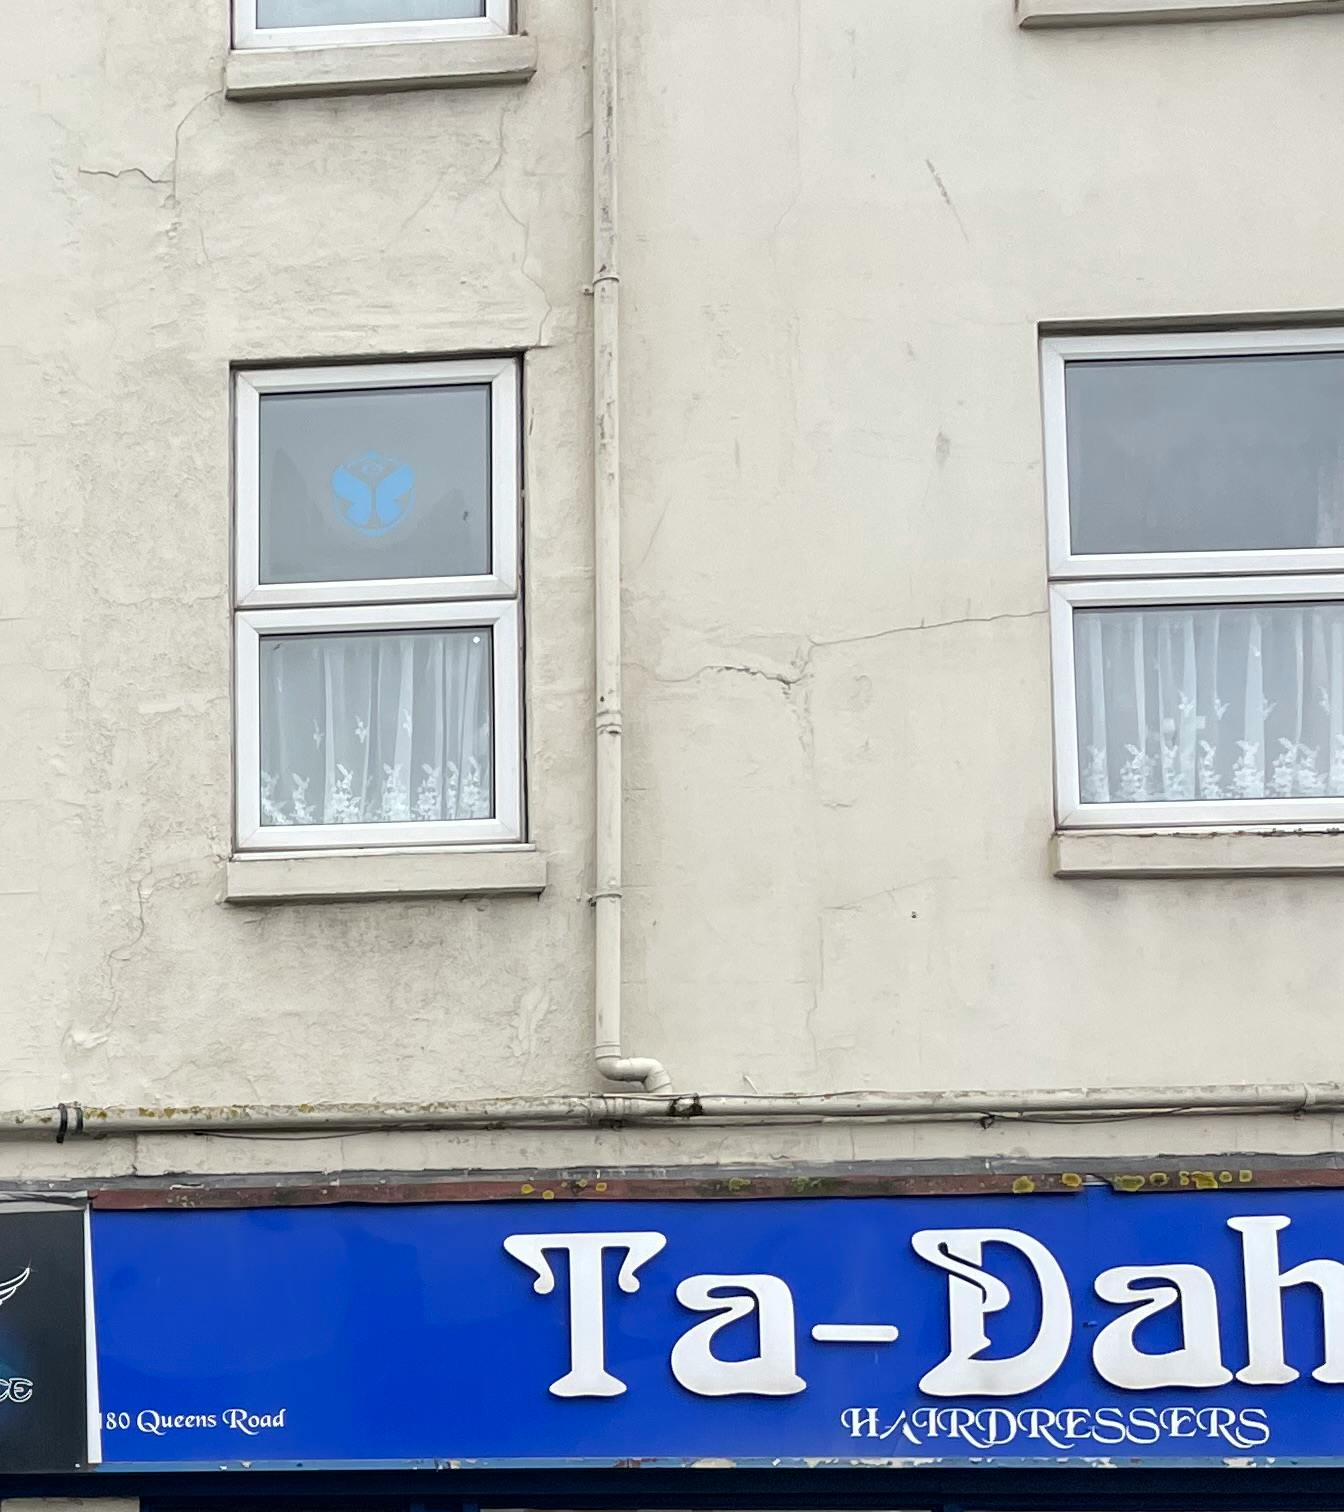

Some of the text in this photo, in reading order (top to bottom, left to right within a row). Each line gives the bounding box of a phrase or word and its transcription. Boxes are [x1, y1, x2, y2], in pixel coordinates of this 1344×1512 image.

[502, 1213, 1344, 1397] Ta-Dah
[136, 1408, 218, 1437] Queens
[222, 1408, 286, 1436] Road
[840, 1406, 1271, 1449] HAIRDRESSERS
